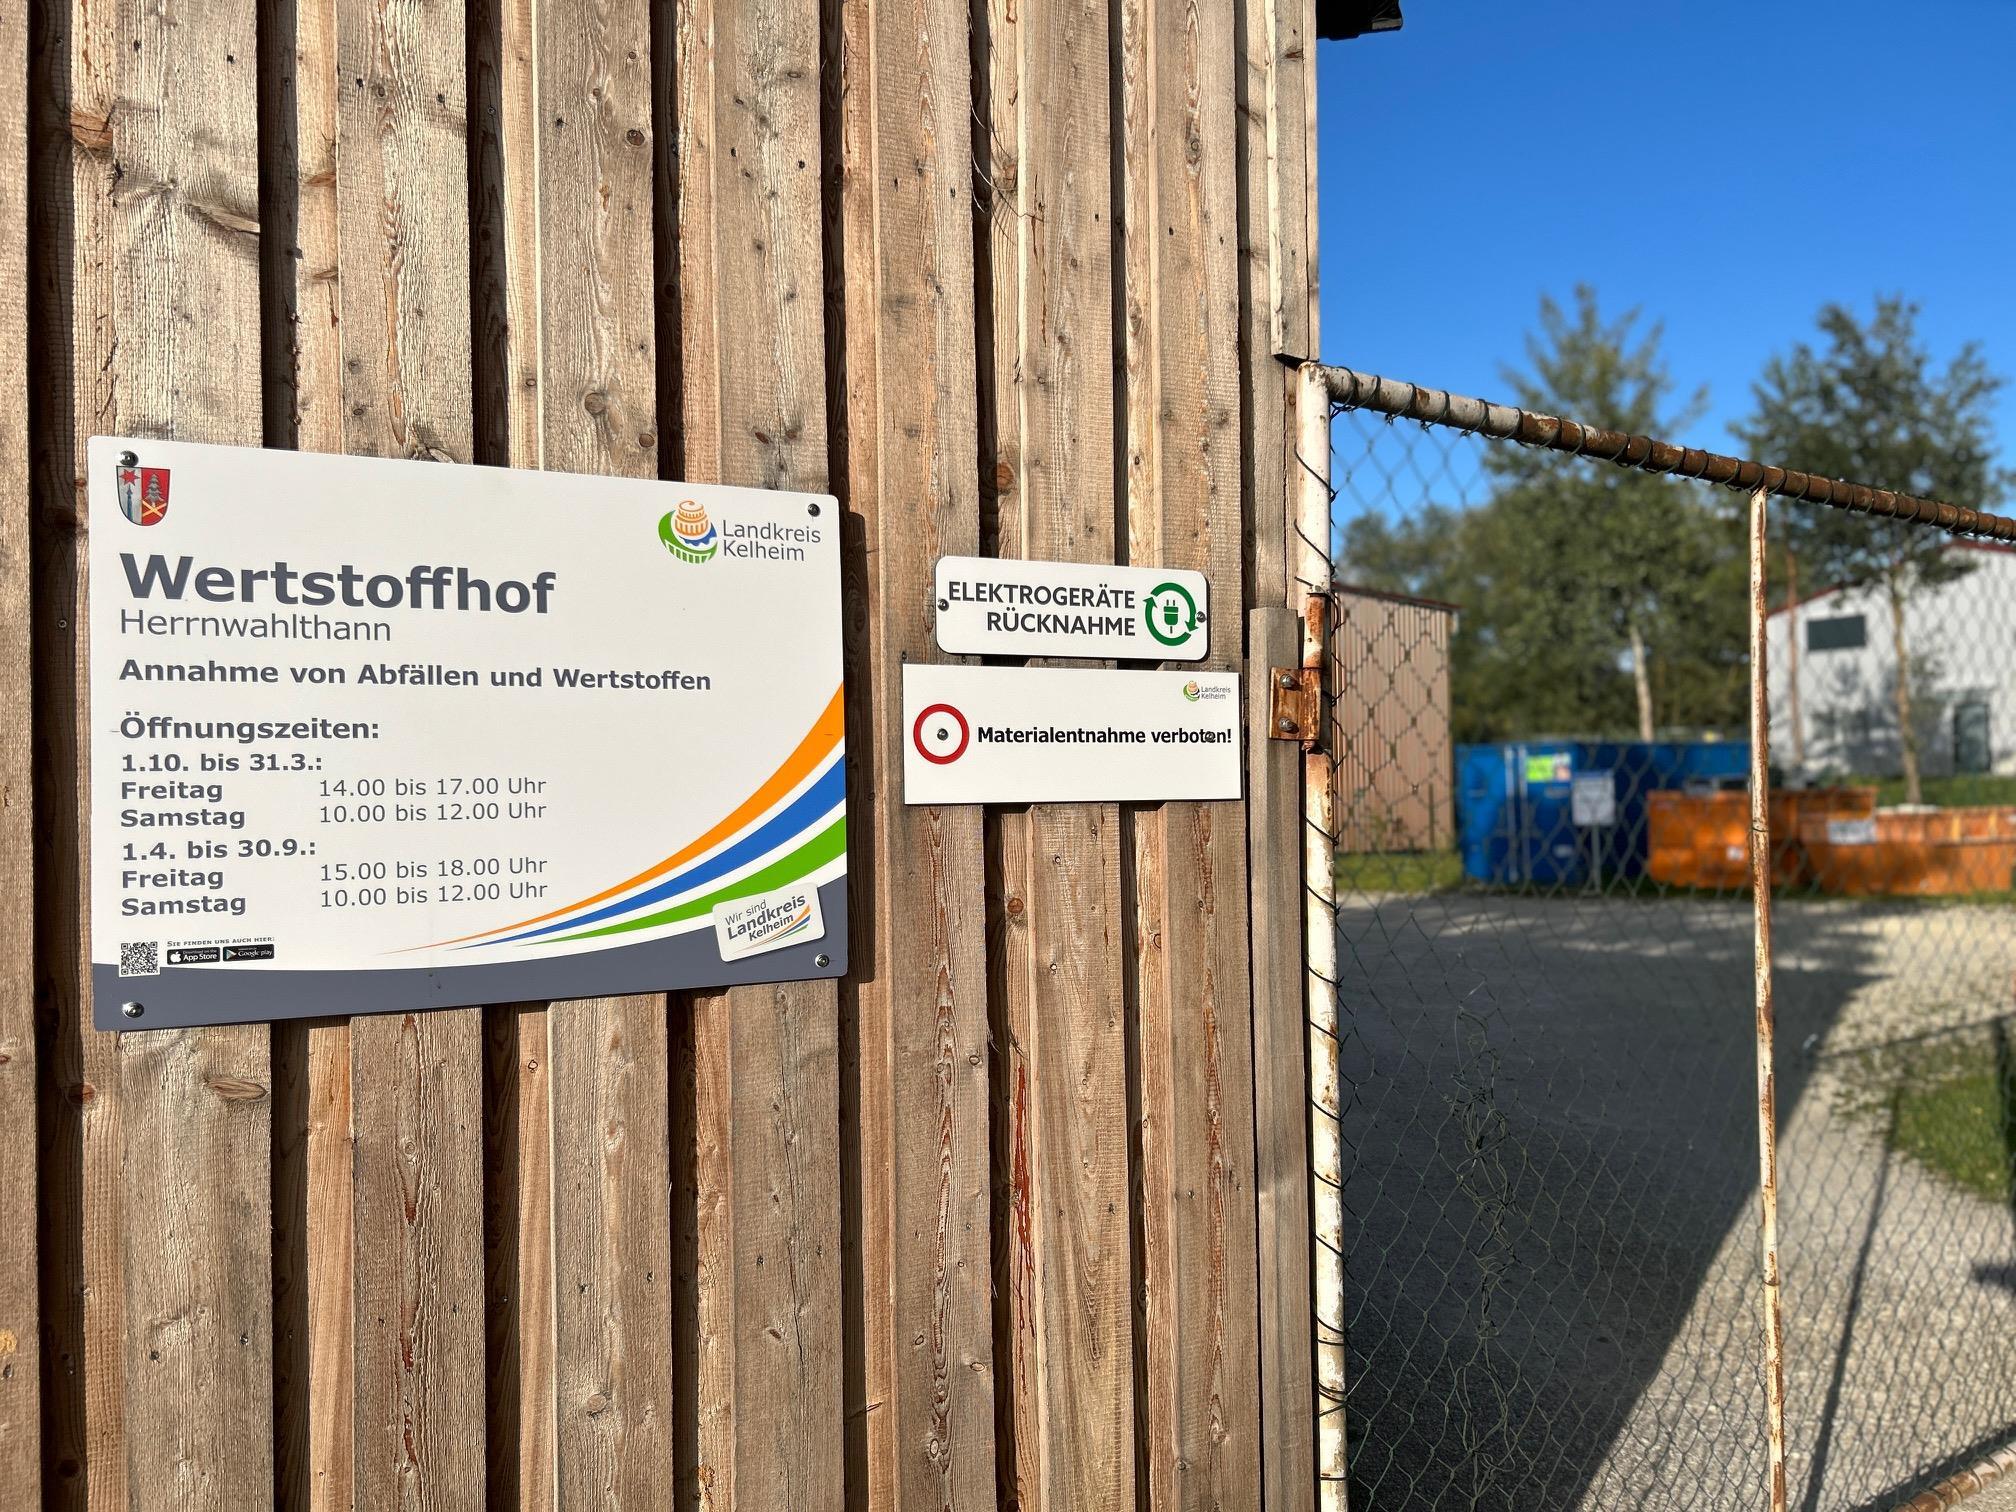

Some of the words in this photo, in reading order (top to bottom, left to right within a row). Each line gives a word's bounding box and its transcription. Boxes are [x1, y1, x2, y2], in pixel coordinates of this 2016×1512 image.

[722, 519, 821, 544] Landkreis
[723, 539, 805, 562] Kelheim
[119, 552, 556, 613] Wertstoffhof
[949, 581, 1135, 609] ELEKTROGERÄTE
[121, 608, 391, 641] Herrnwahlthann
[987, 607, 1136, 636] RÜCKNAHME
[119, 659, 279, 682] Annahme
[290, 668, 345, 684] von
[357, 663, 479, 687] Abfällen
[490, 666, 542, 687] und
[553, 668, 711, 690] Wertstoffen
[120, 712, 380, 743] Öffnungszeiten:
[978, 727, 1146, 743] Materialentnahme
[121, 754, 190, 773] 1.10.
[200, 754, 240, 772] bis
[249, 753, 323, 772] 31.3.:
[121, 781, 223, 802] Freitag
[319, 779, 385, 797] 14.00
[395, 778, 427, 796] bis
[437, 778, 499, 795] 17.00
[508, 778, 547, 795] Uhr
[120, 808, 246, 830] Samstag
[320, 805, 385, 824] 10.00
[395, 804, 427, 822] bis
[437, 803, 499, 821] 12.00
[508, 802, 547, 819] Uhr
[122, 842, 176, 861] 1.4.
[187, 841, 228, 859] bis
[238, 839, 316, 857] 30.9.:
[122, 869, 224, 890] Freitag
[320, 863, 386, 881] 15.00
[396, 861, 428, 879] bis
[438, 859, 500, 877] 18.00
[509, 857, 548, 875] Uhr
[121, 895, 247, 917] Samstag
[321, 889, 386, 908] 10.00
[396, 887, 428, 904] bis
[438, 884, 500, 902] 12.00
[509, 882, 548, 899] Uhr
[725, 911, 742, 926] Wir
[746, 899, 767, 916] sind
[728, 894, 805, 940] Landkreis
[749, 914, 794, 941] Kelheim
